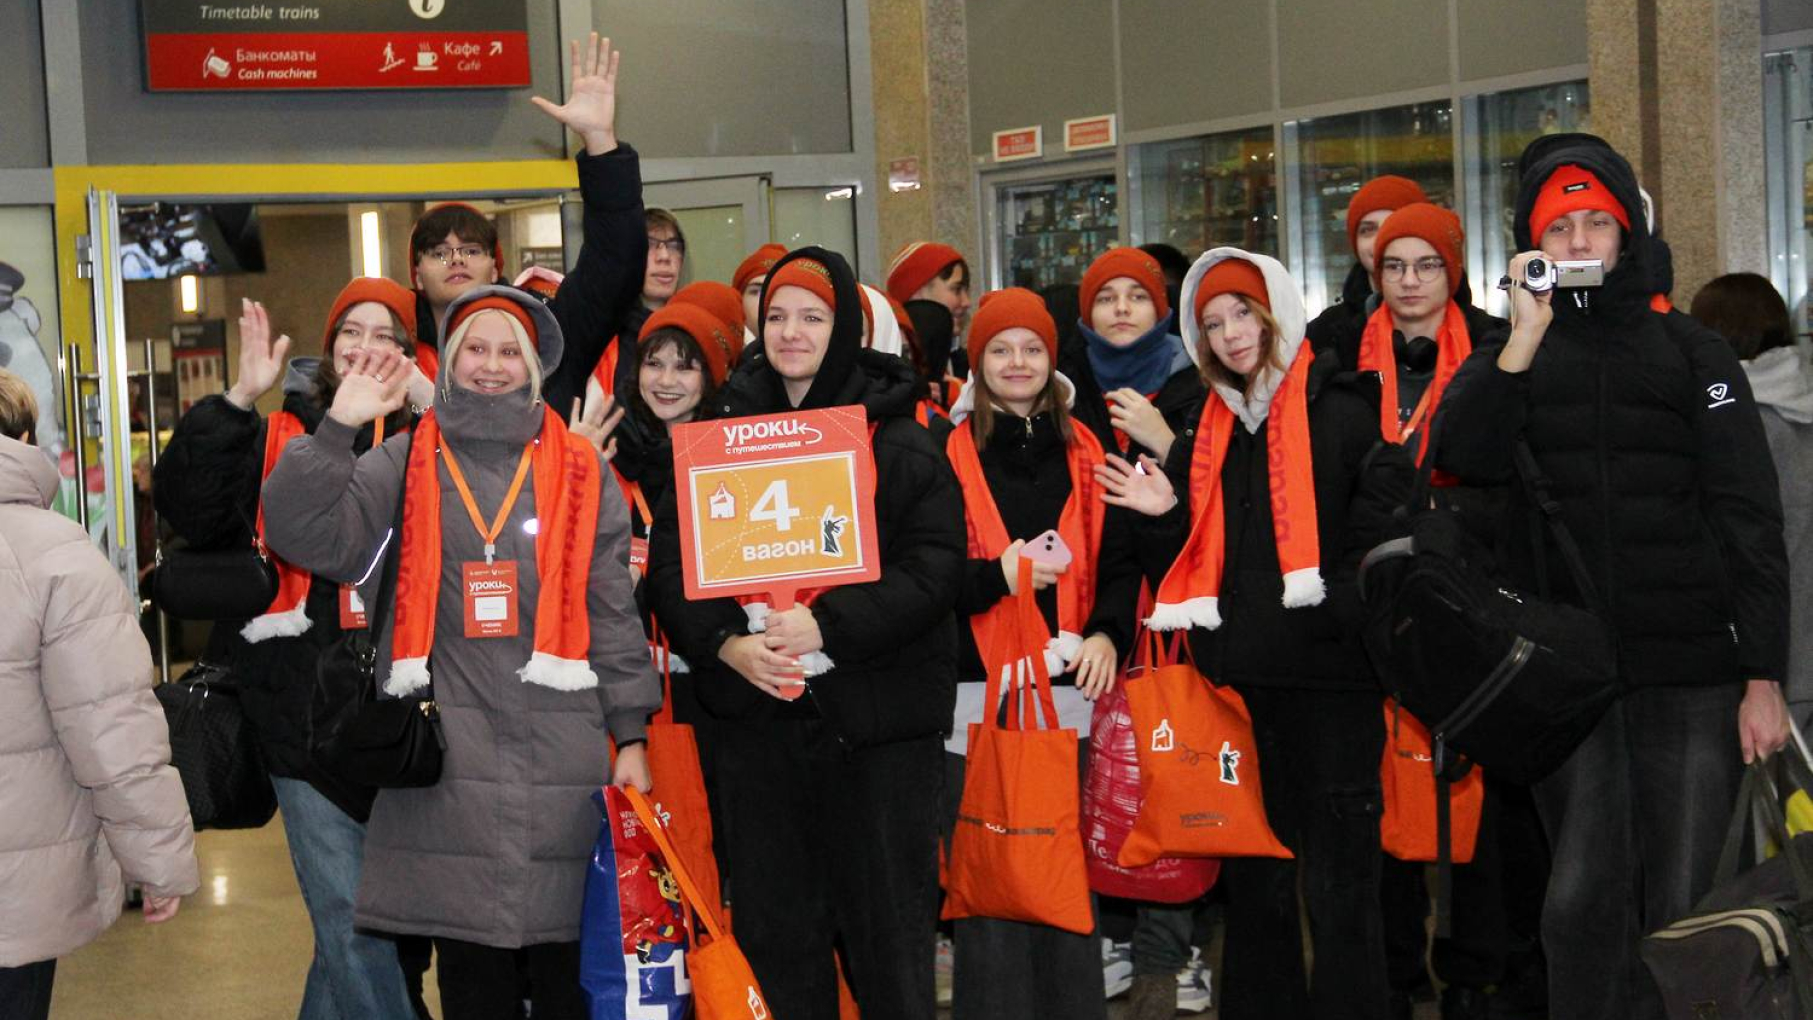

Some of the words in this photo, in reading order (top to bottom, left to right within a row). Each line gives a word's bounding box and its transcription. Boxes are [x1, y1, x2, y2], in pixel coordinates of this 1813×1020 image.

[200, 4, 273, 19] Timetable
[280, 5, 320, 19] trains
[236, 48, 316, 63] Банкоматы
[444, 41, 481, 58] Кафе
[238, 68, 264, 80] Cash
[266, 67, 318, 79] machines
[723, 419, 798, 446] уроки
[749, 479, 800, 531] 4
[742, 539, 815, 561] вагон
[469, 580, 503, 591] уроки
